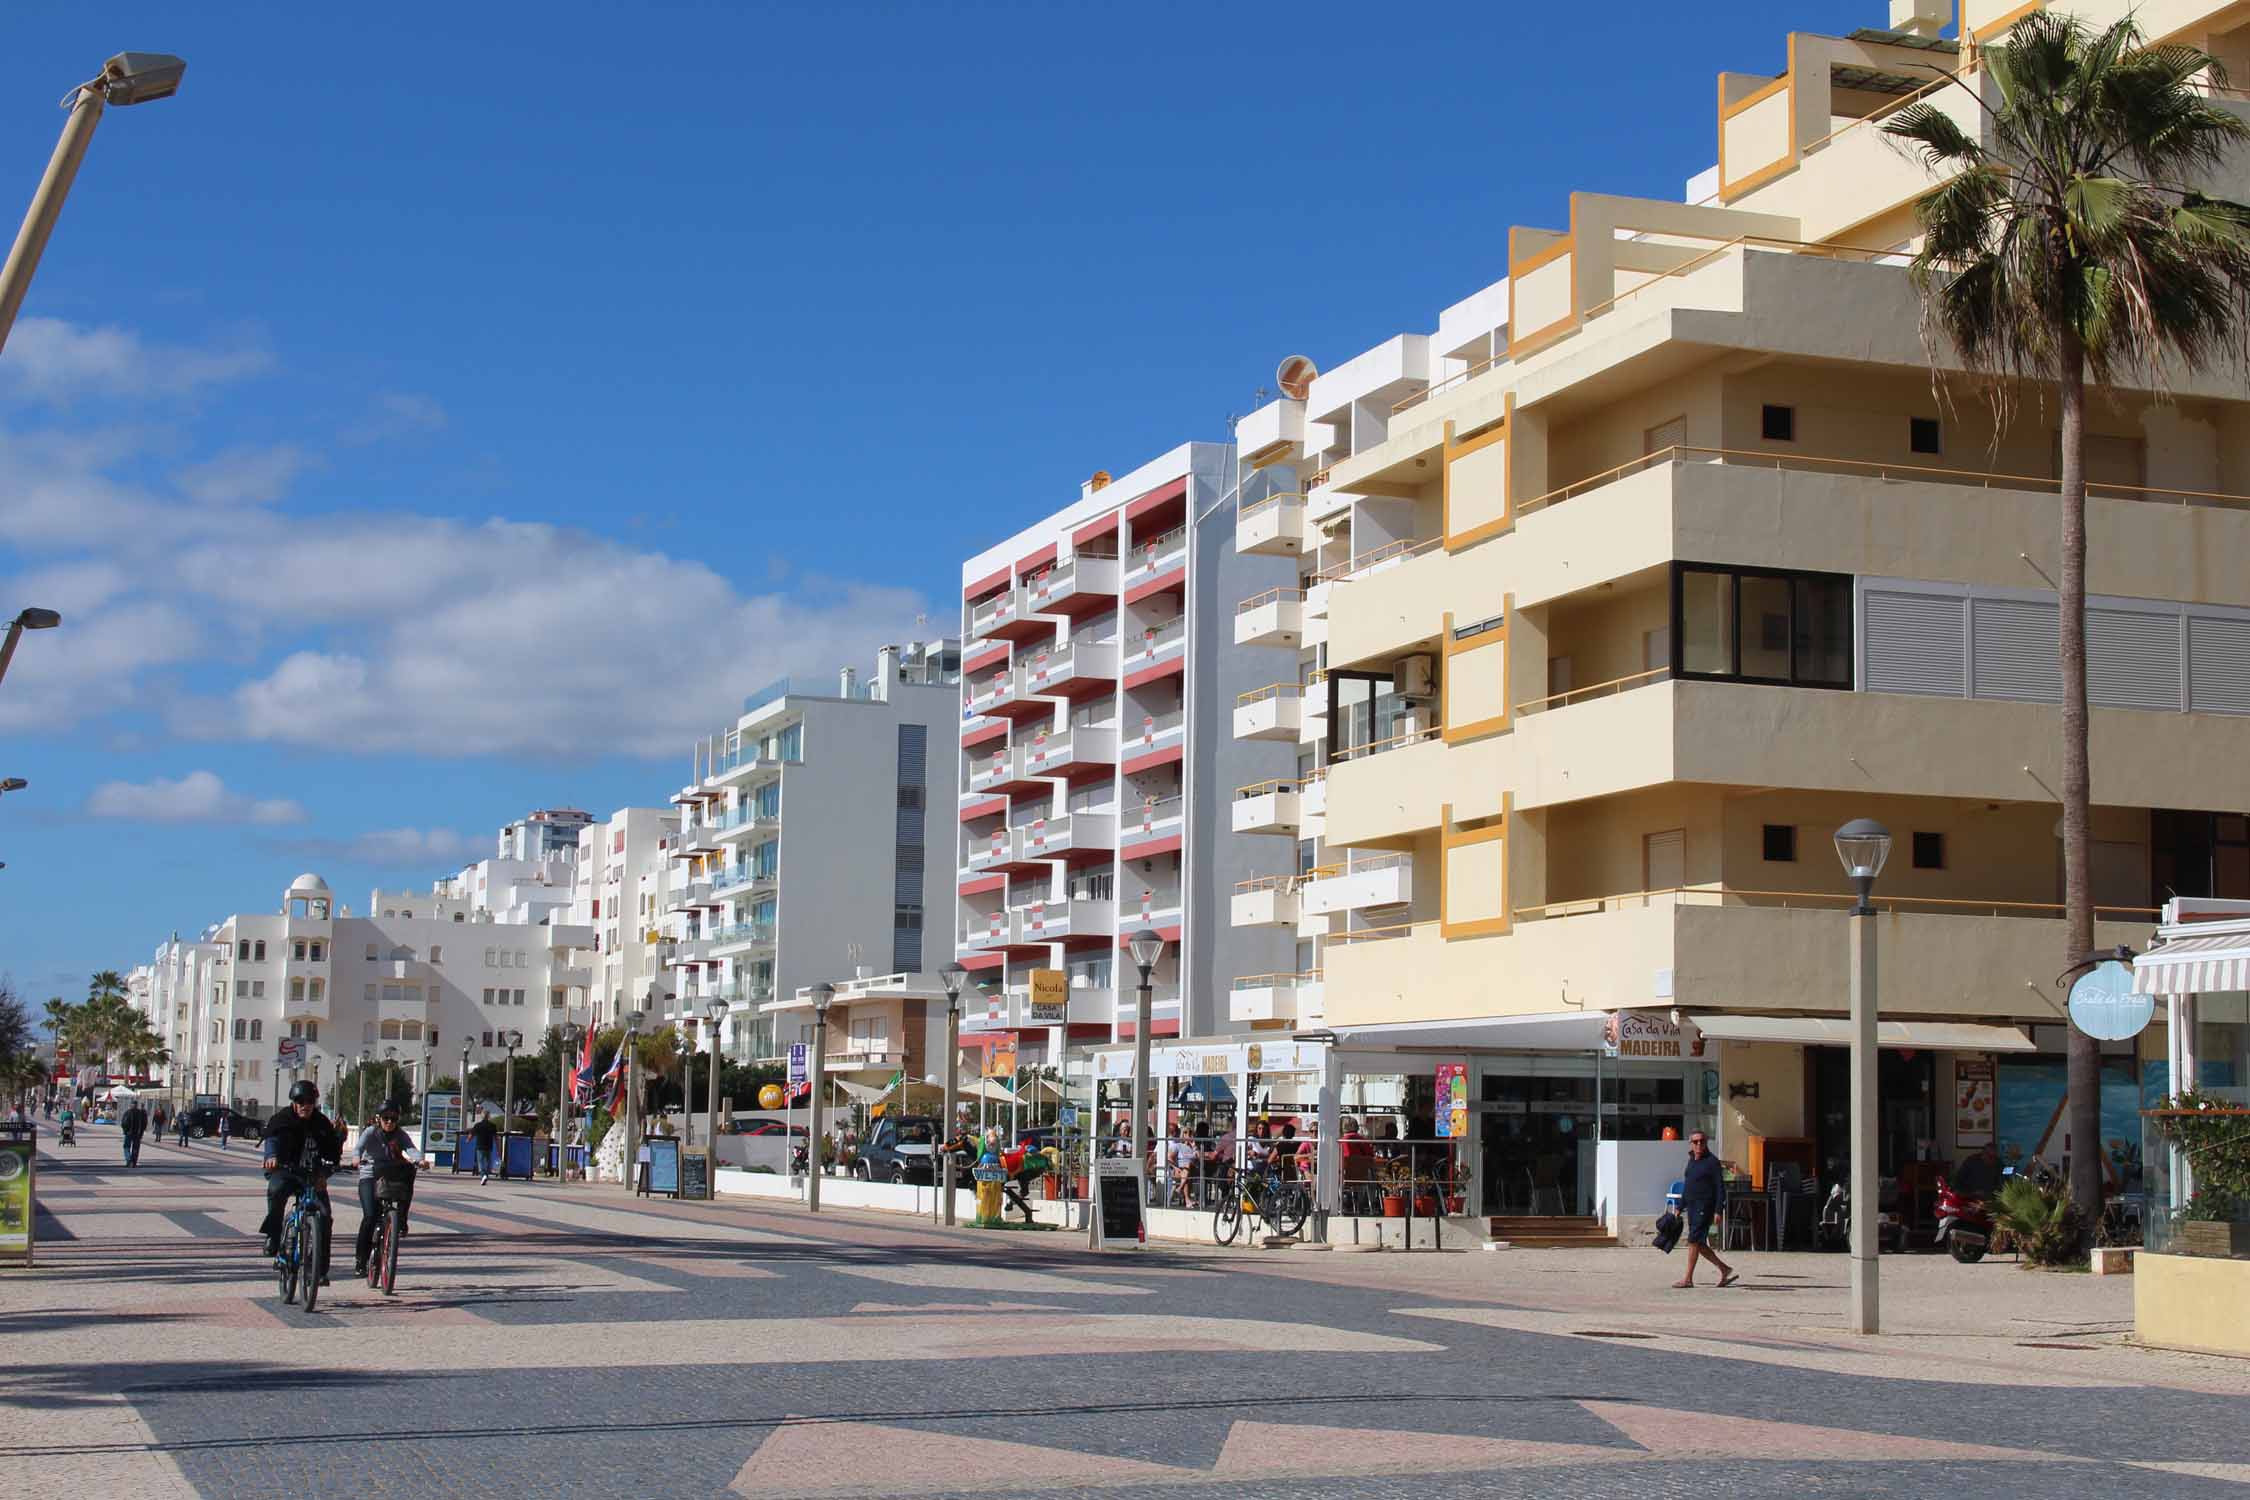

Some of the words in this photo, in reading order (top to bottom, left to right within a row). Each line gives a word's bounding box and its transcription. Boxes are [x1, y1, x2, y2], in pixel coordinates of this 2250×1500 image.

[1034, 983, 1063, 993] Nicola
[1646, 1018, 1659, 1035] da
[1620, 1040, 1680, 1056] MADEIRA
[1202, 1056, 1228, 1072] MADEIRA
